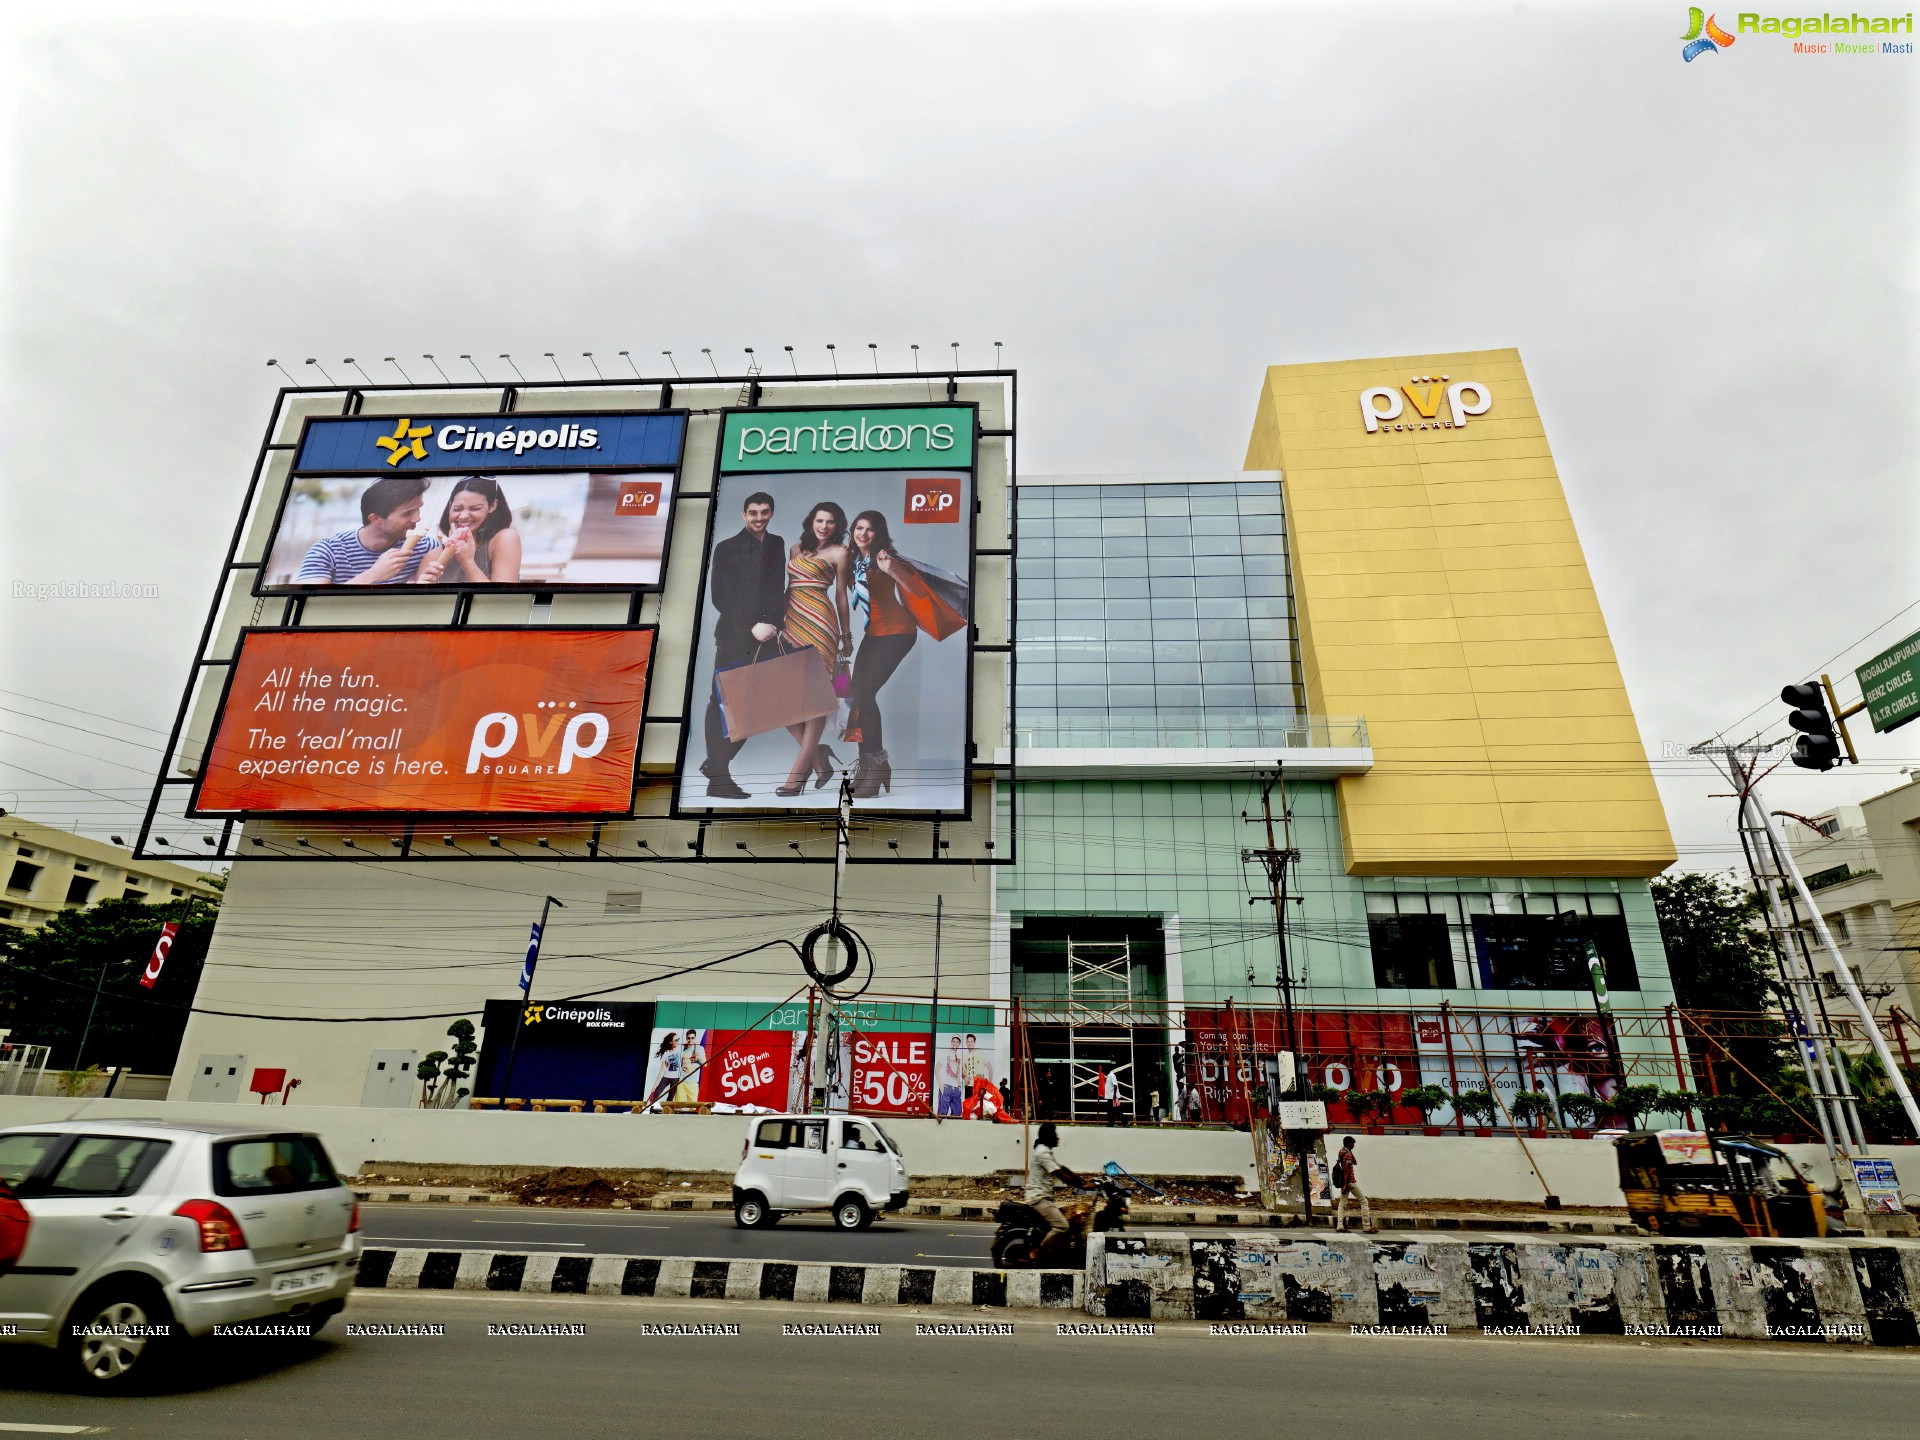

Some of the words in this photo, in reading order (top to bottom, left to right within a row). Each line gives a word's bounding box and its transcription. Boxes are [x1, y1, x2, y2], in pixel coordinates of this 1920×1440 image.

[1382, 420, 1452, 432] SQUARE
[437, 424, 598, 455] Cinépolis
[737, 417, 954, 461] pantaloons
[261, 667, 293, 688] All
[299, 667, 332, 688] the
[340, 667, 380, 688] fun.
[1866, 684, 1887, 704] BENZ
[1885, 669, 1914, 693] CIRLCE
[254, 691, 286, 712] All
[292, 692, 326, 712] the
[334, 694, 408, 717] magic.
[1891, 691, 1919, 714] CIRCLE
[248, 728, 286, 749] The
[465, 712, 610, 775] pvp
[238, 754, 360, 779] experience
[368, 755, 385, 774] is
[393, 753, 449, 775] here.
[482, 765, 555, 775] SQUARE
[545, 1006, 611, 1023] Cinépolis
[1199, 1031, 1228, 1041] Comng
[723, 1054, 756, 1072] Love
[756, 1051, 770, 1062] with
[727, 1050, 739, 1061] in
[854, 1040, 927, 1065] SALE
[721, 1063, 775, 1098] Sale
